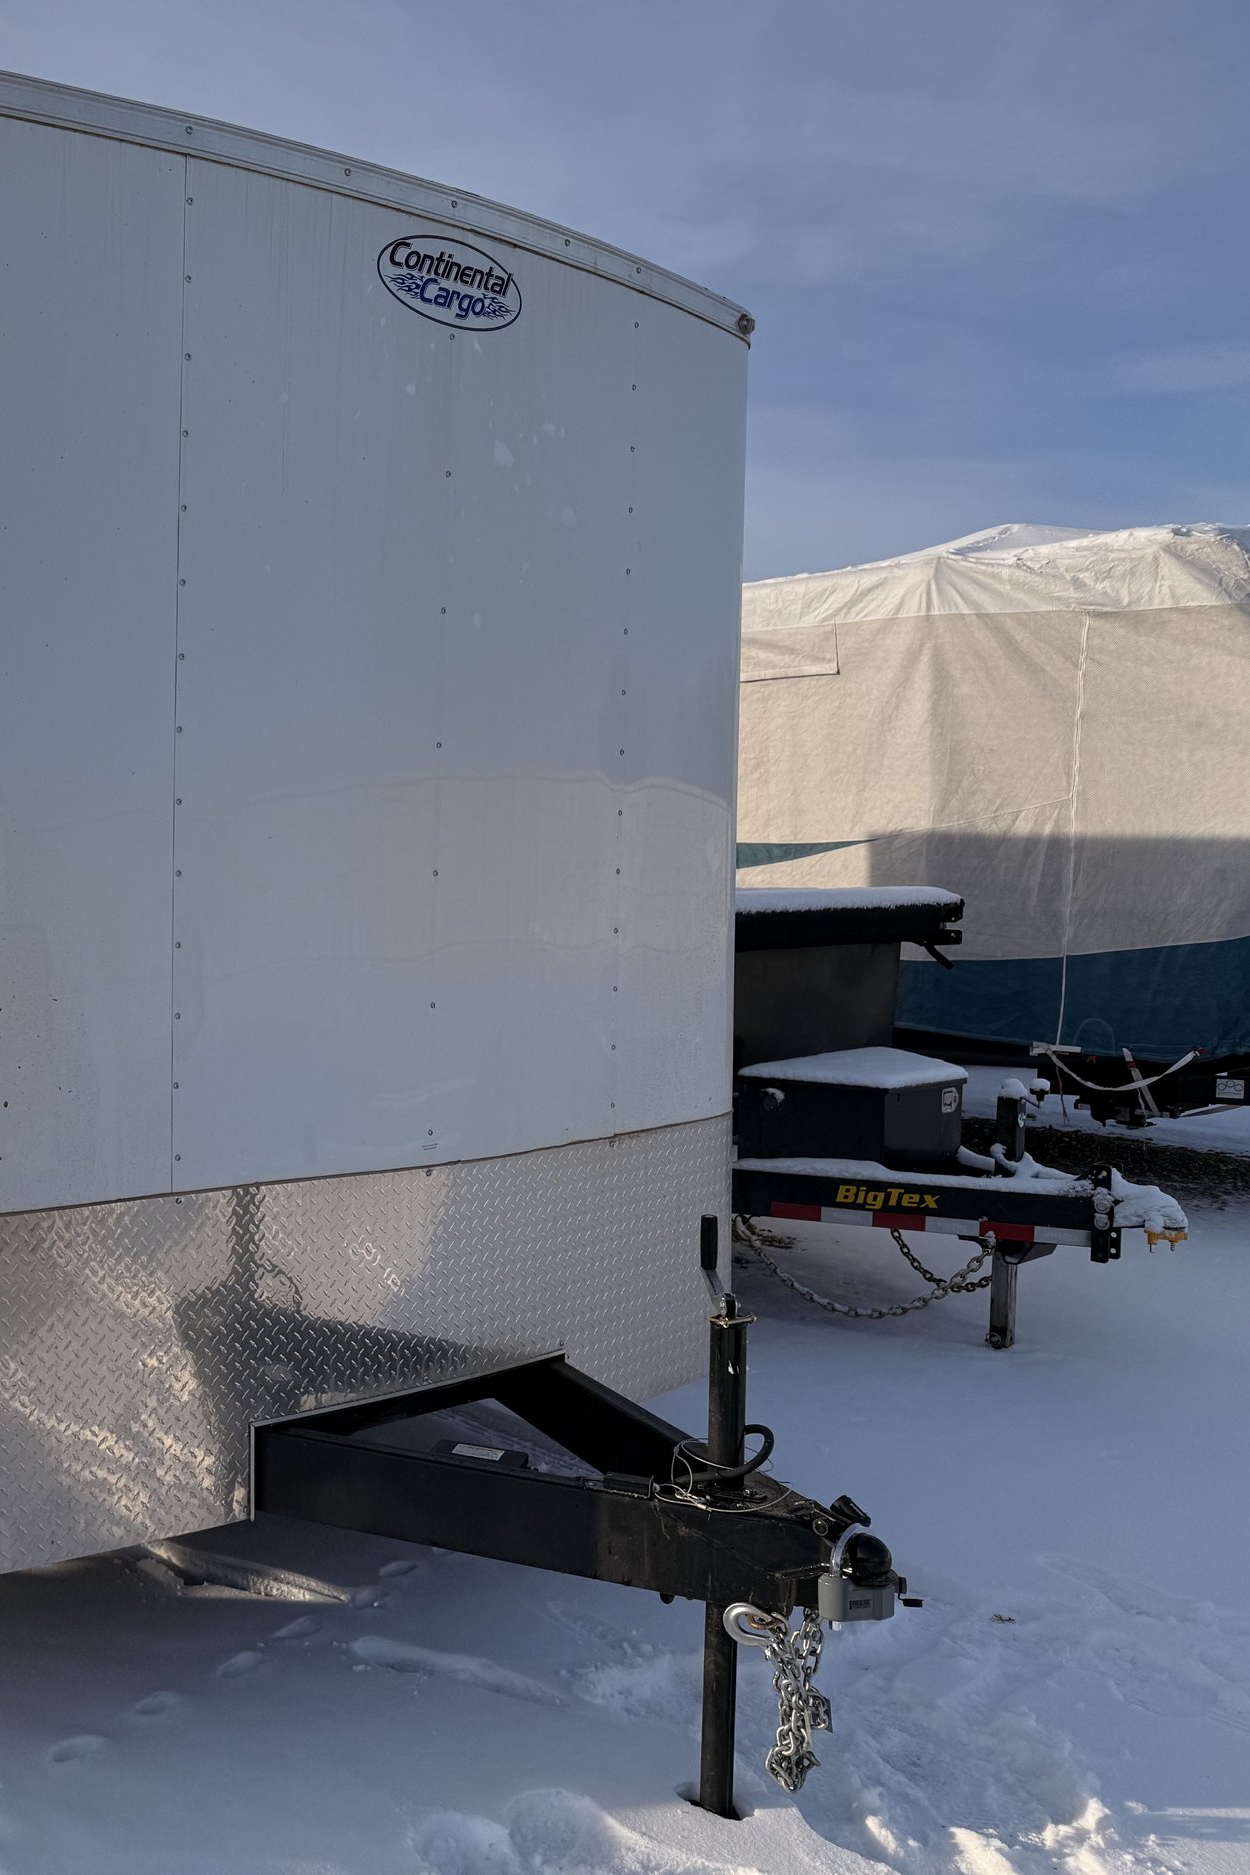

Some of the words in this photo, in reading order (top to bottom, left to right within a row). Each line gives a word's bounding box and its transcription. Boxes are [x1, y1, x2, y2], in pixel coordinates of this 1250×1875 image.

[389, 241, 513, 297] Continental
[419, 277, 486, 319] Cargo
[835, 1185, 940, 1210] BigTex
